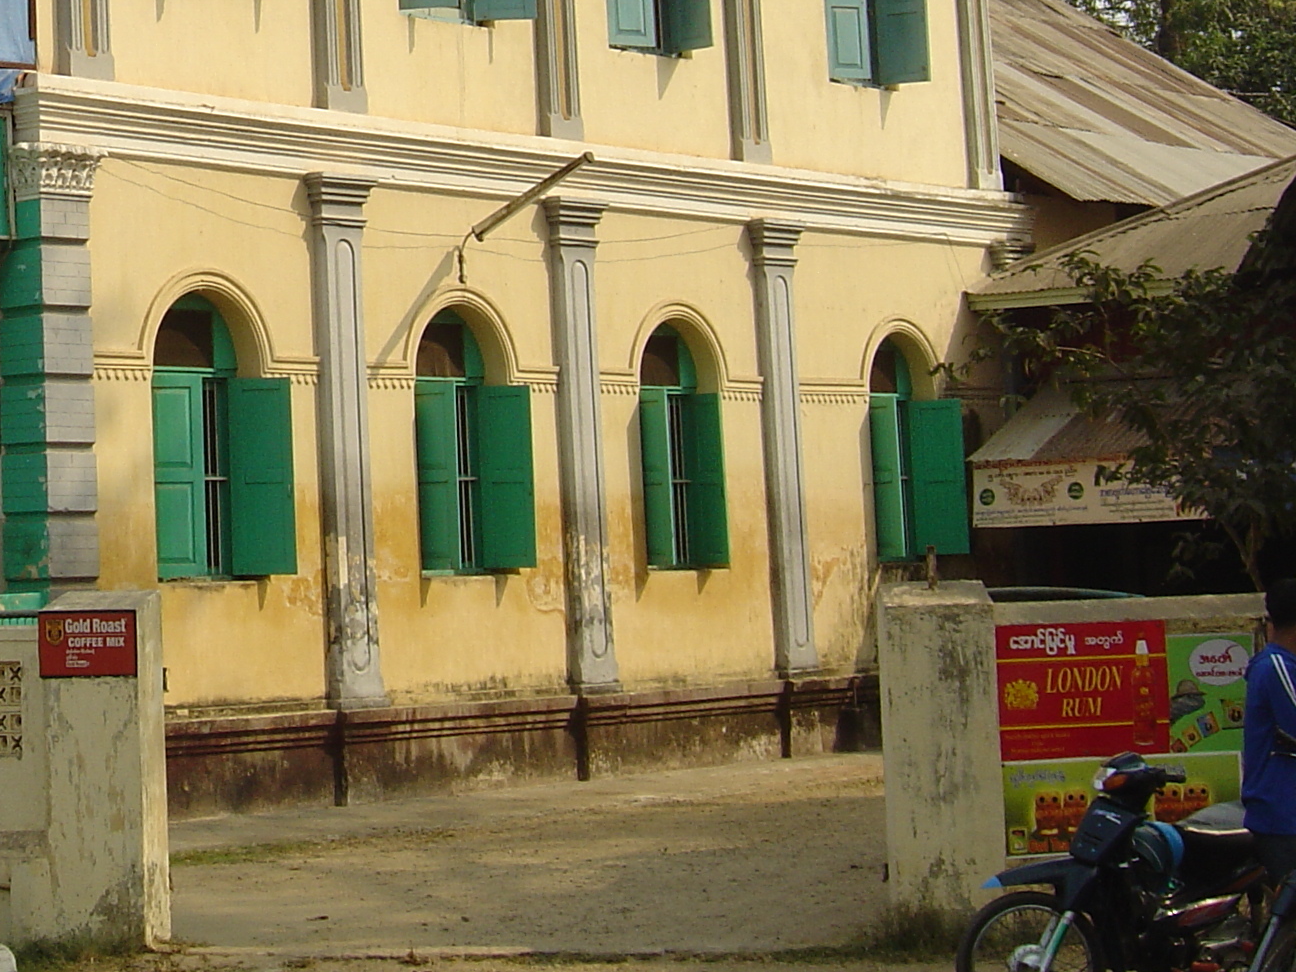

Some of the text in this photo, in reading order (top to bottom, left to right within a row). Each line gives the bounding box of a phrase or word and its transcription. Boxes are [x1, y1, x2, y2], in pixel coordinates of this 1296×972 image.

[65, 618, 126, 633] Gold Roast
[68, 636, 125, 647] COFFEE MIX
[1085, 631, 1123, 649] အတွက်
[1046, 665, 1123, 693] LONDON
[1061, 697, 1102, 717] RUM
